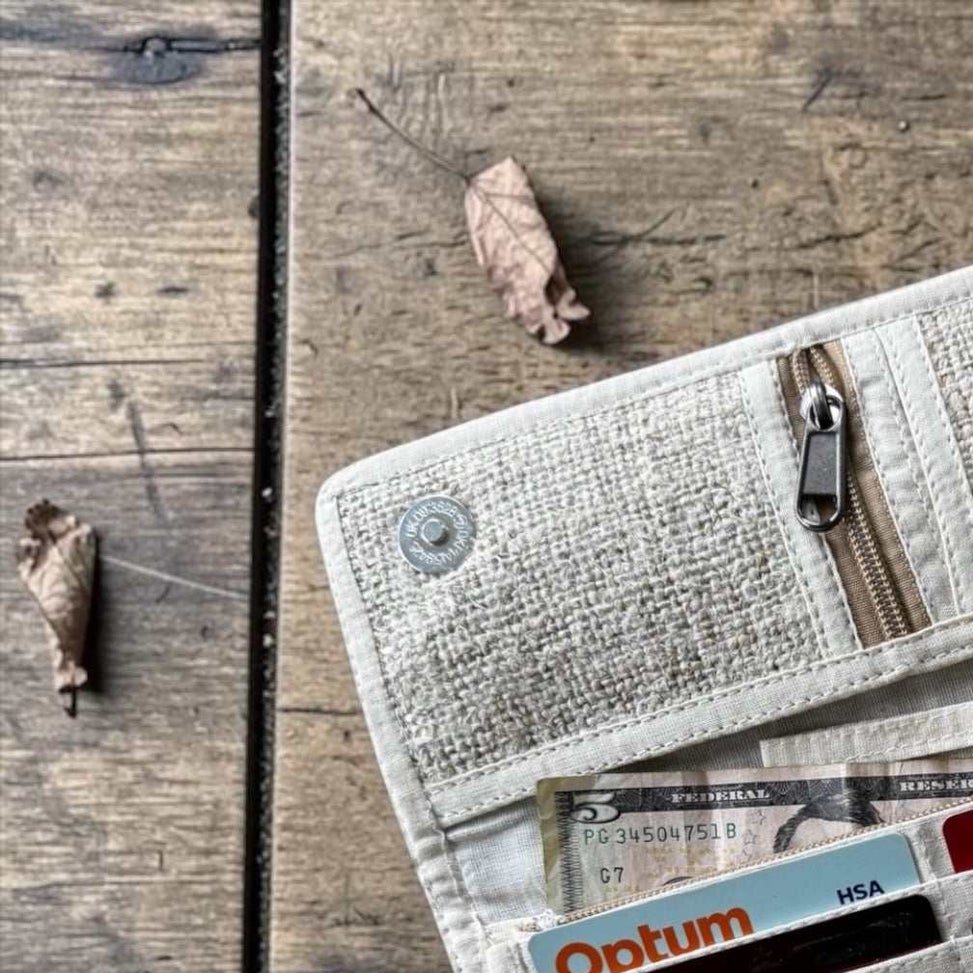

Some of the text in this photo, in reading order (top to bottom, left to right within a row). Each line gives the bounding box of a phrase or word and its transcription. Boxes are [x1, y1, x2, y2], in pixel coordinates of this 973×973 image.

[570, 791, 621, 824] 5
[669, 789, 771, 804] FEDERAL
[601, 866, 624, 884] G7
[837, 879, 885, 905] HSA
